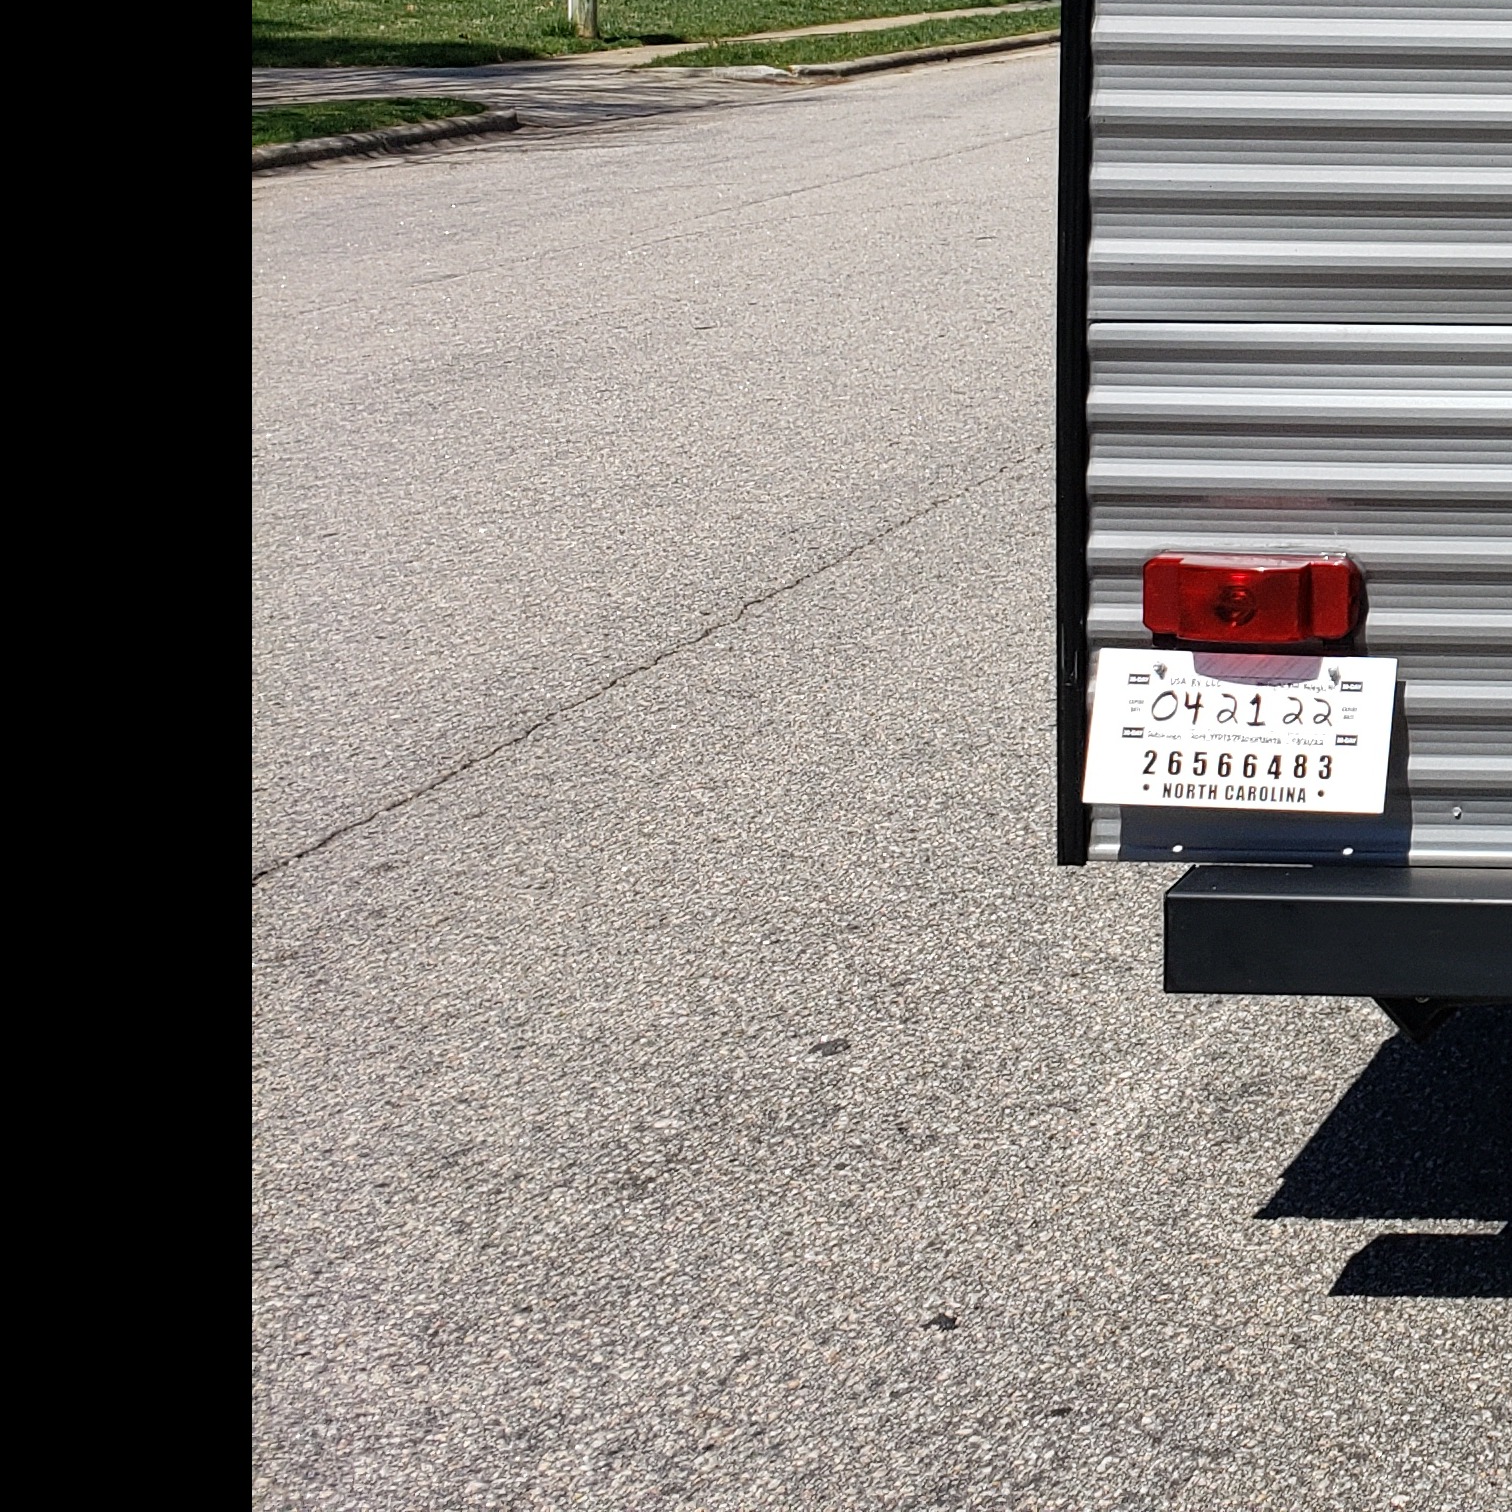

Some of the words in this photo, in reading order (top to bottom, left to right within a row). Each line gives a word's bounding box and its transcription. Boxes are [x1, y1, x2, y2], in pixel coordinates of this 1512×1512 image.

[1142, 749, 1333, 780] 26566483
[1162, 782, 1218, 801] NORTH
[1224, 784, 1307, 804] CAROLINA
